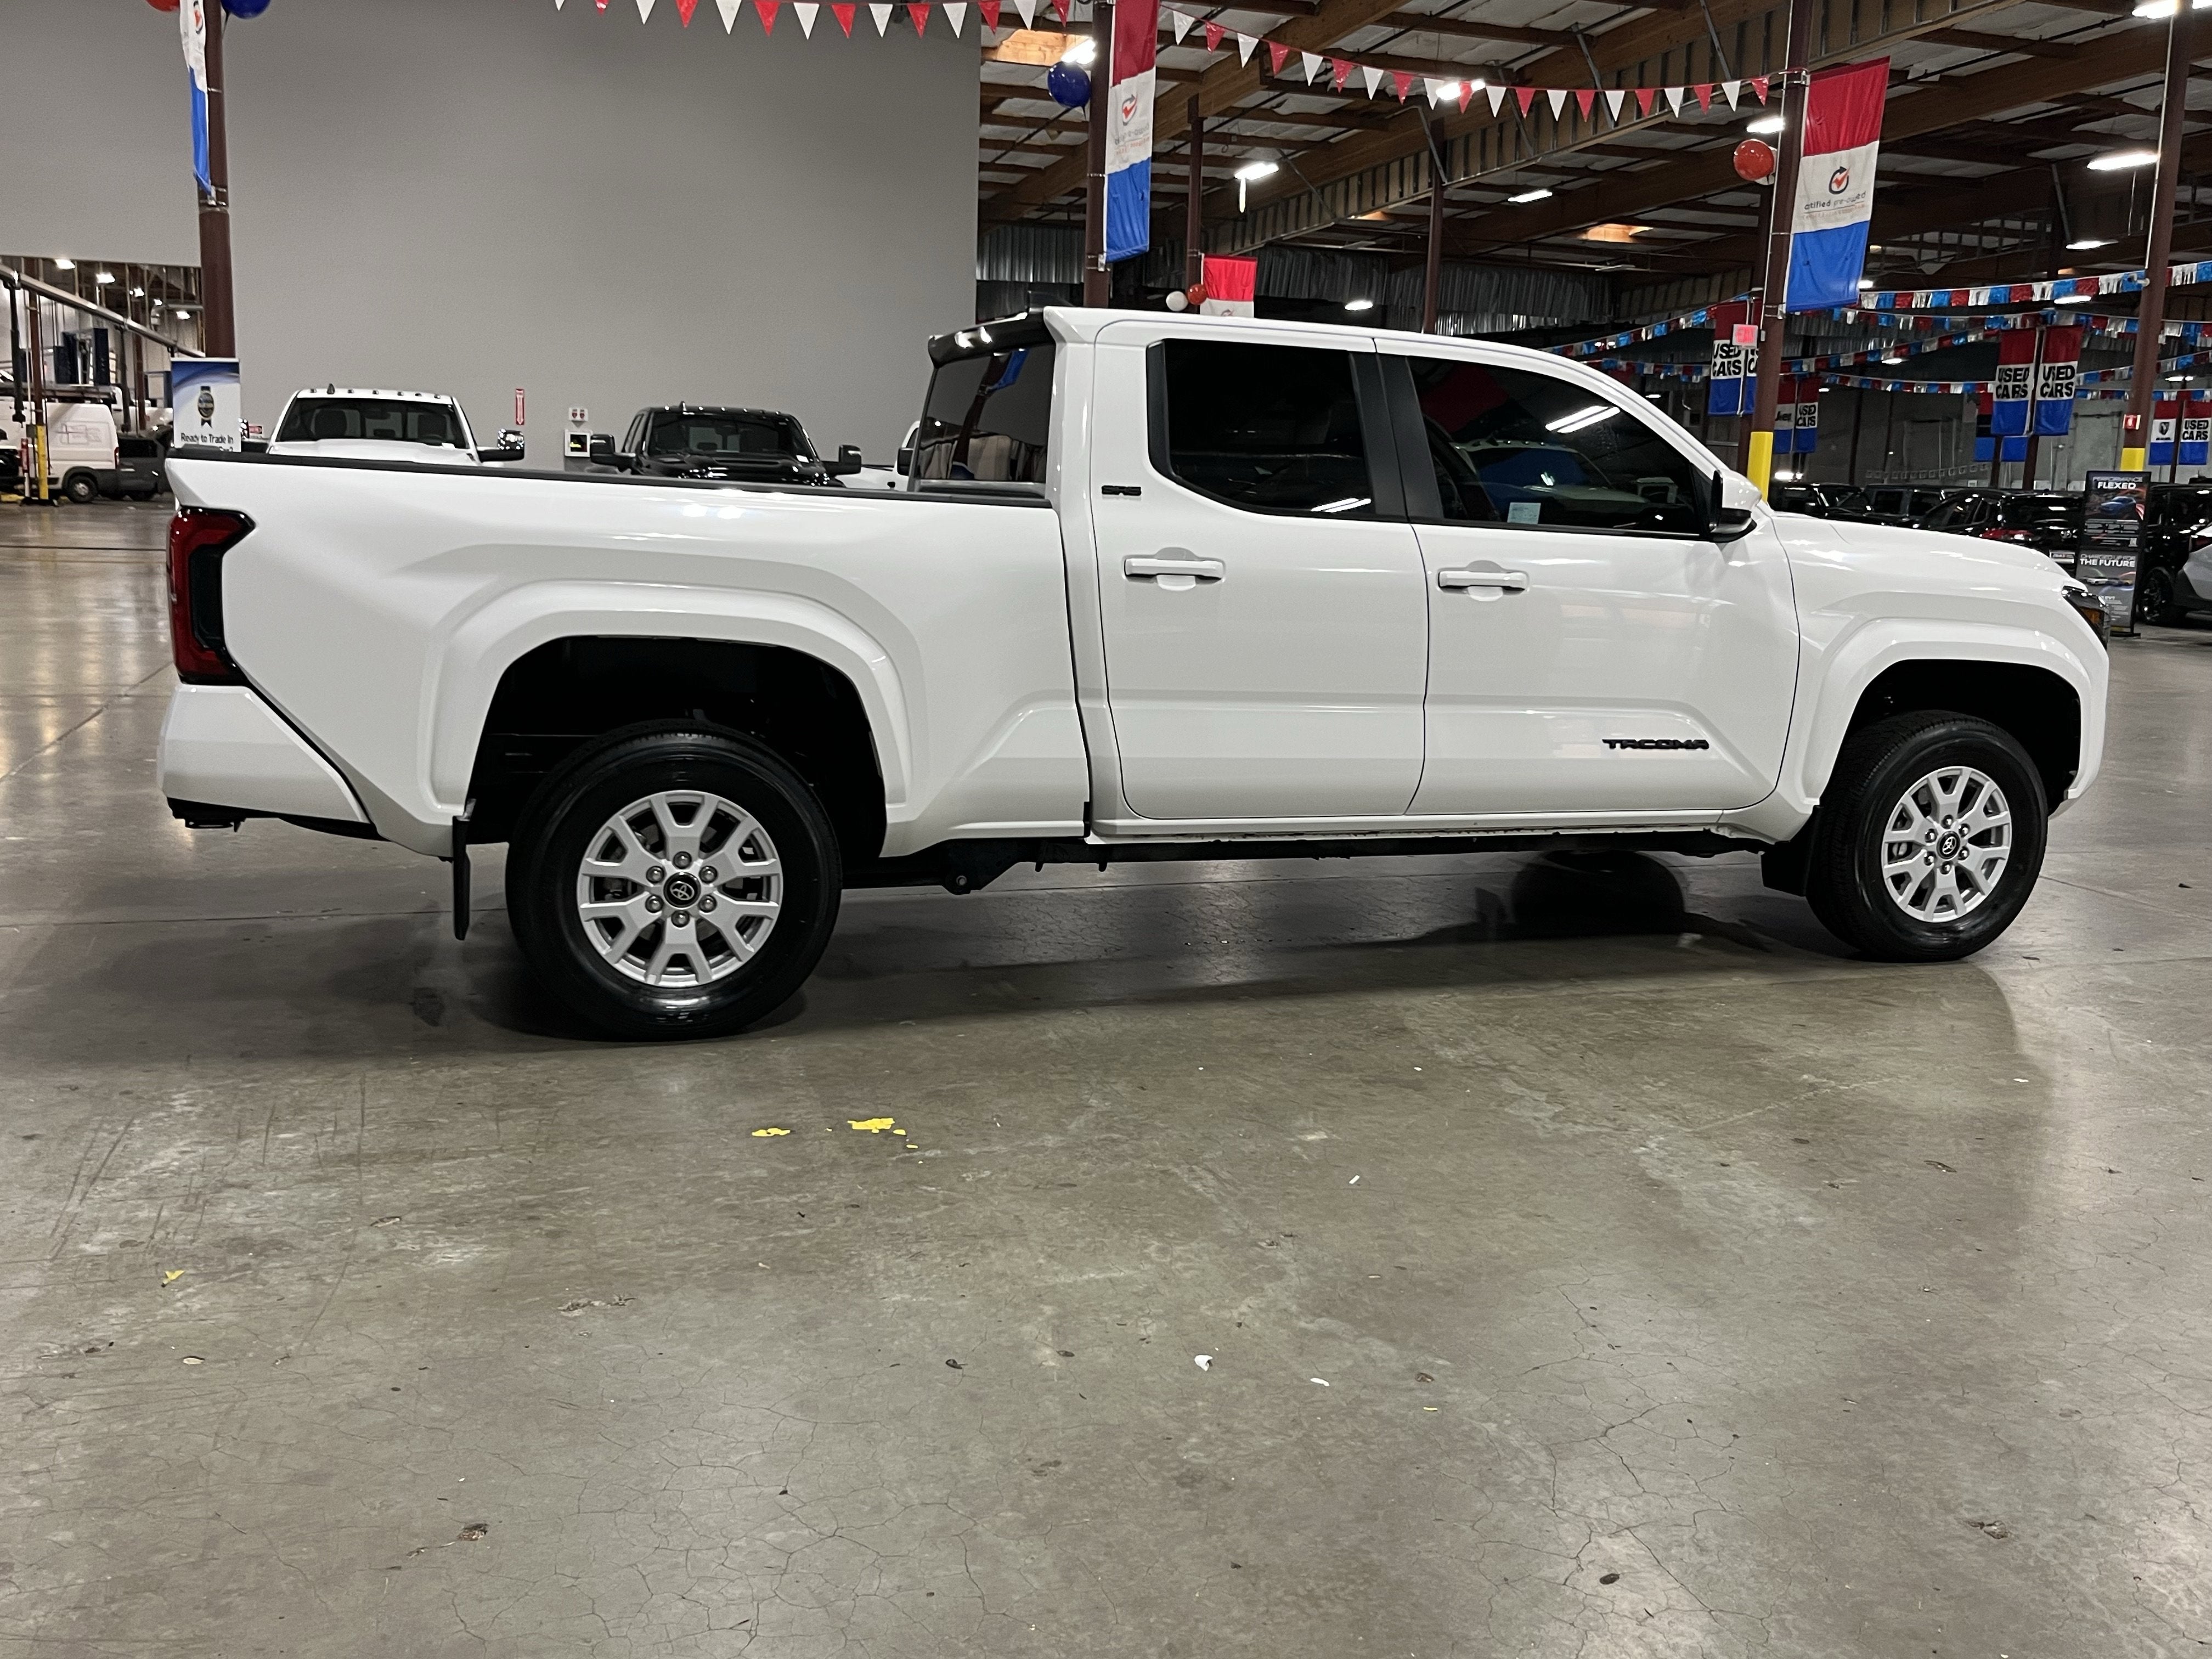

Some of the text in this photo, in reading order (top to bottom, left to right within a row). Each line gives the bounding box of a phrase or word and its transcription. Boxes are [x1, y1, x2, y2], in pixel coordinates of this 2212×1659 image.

[1998, 366, 2030, 382] USED
[2043, 365, 2075, 381] USED
[1995, 383, 2028, 399] CARS
[2040, 381, 2074, 398] CARS
[2184, 420, 2209, 430] USED
[180, 432, 234, 444] Ready to Trade In
[2182, 430, 2208, 441] CARS
[1601, 739, 1709, 749] TACOMA
